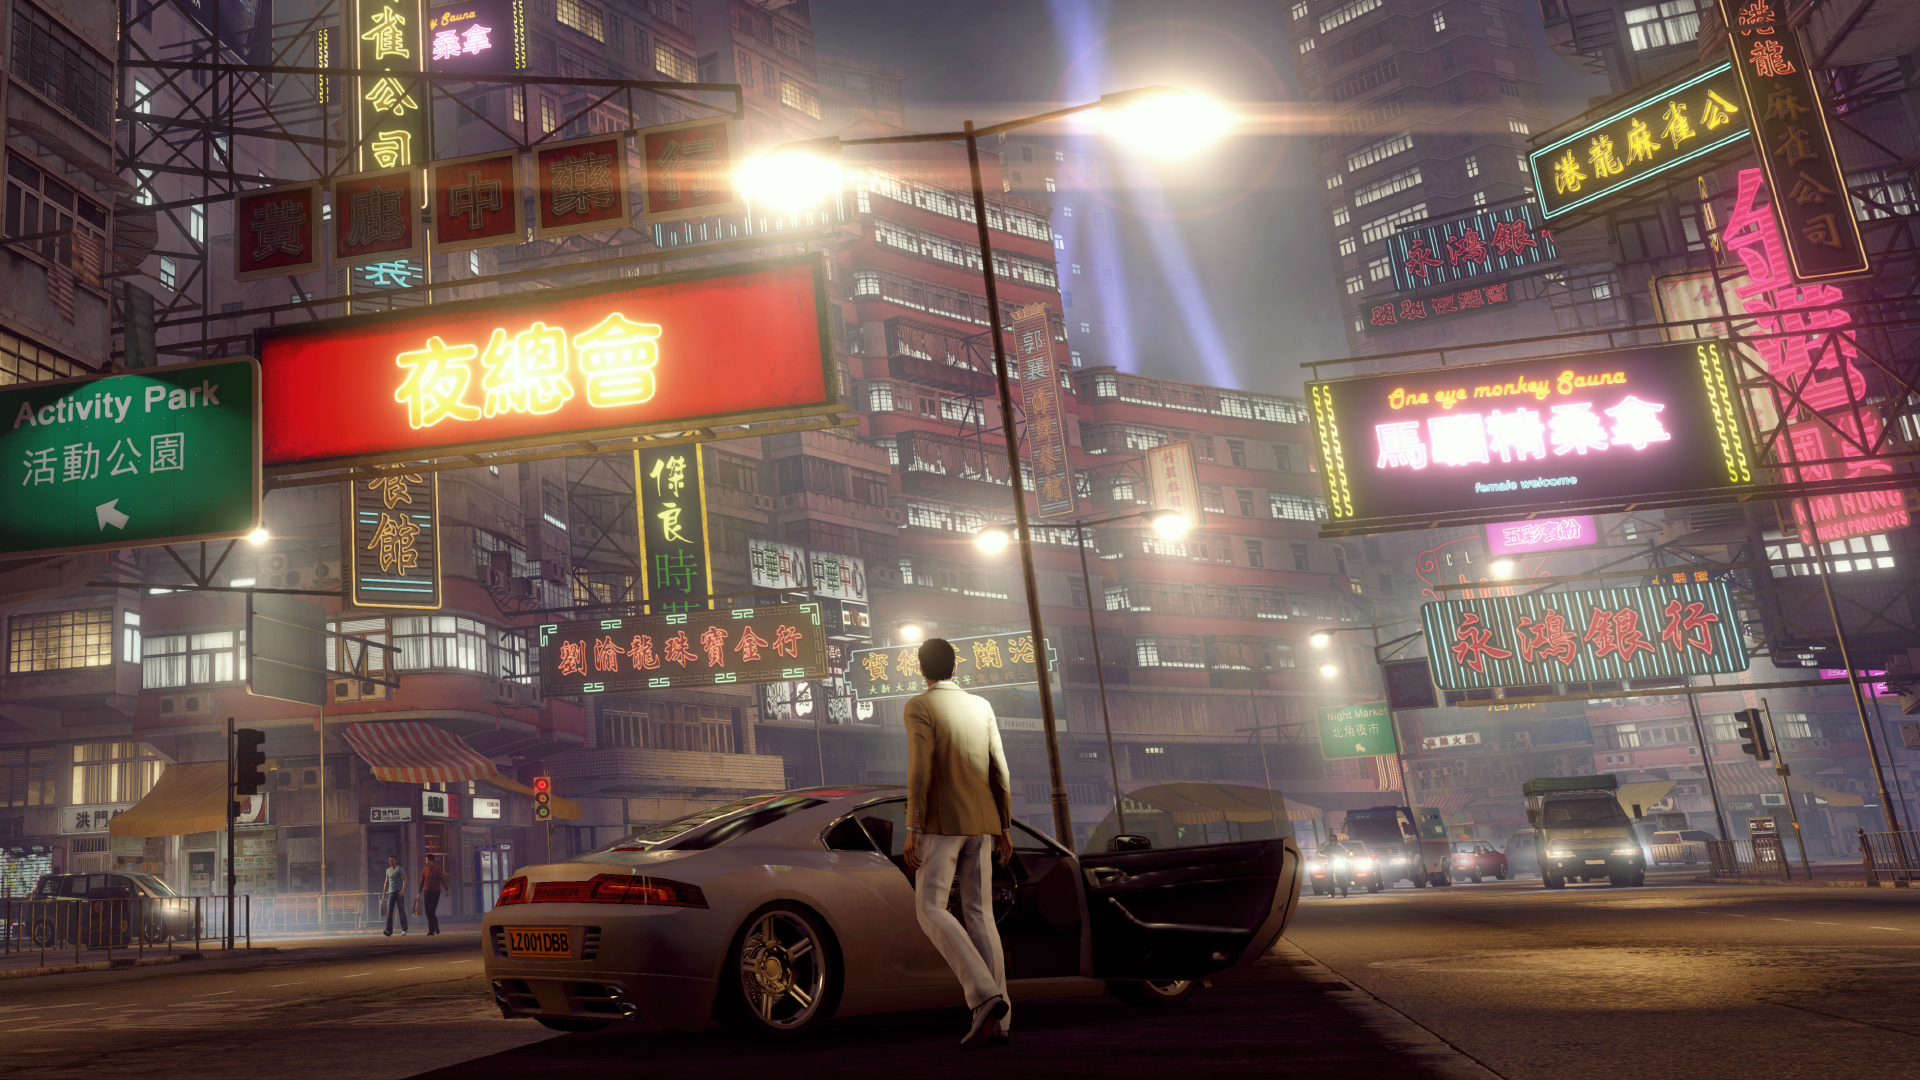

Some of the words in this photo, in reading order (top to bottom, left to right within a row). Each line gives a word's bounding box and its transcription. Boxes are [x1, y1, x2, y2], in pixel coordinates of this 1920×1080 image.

[433, 24, 492, 60] 桑拿
[441, 11, 476, 27] Sauna
[361, 0, 419, 168] 雀公司
[1554, 90, 1739, 195] 港龍麻雀公
[1405, 219, 1555, 278] 永鴻銀
[394, 312, 663, 430] 夜總會
[1388, 387, 1429, 409] One
[1435, 387, 1467, 409] eye
[1474, 376, 1550, 400] monkey
[1557, 370, 1626, 394] Sauna
[13, 392, 132, 429] Activity
[145, 380, 220, 413] Park
[22, 432, 185, 487] 活動公園
[1475, 479, 1517, 493] female
[1520, 475, 1577, 490] welcome
[1795, 496, 1837, 525] KIM
[1840, 488, 1901, 516] HONG
[1801, 522, 1847, 545] CINESE
[1847, 510, 1908, 535] PRODUCTS
[751, 540, 805, 588] 中華中心
[811, 551, 865, 599] 中華中心
[862, 636, 1036, 682] 寶德蘭浴
[1452, 600, 1718, 673] 永鴻銀行
[1327, 711, 1352, 722] Night
[1355, 707, 1388, 718] Market
[1332, 722, 1379, 738] 北角夜市
[534, 887, 579, 896] ANZER
